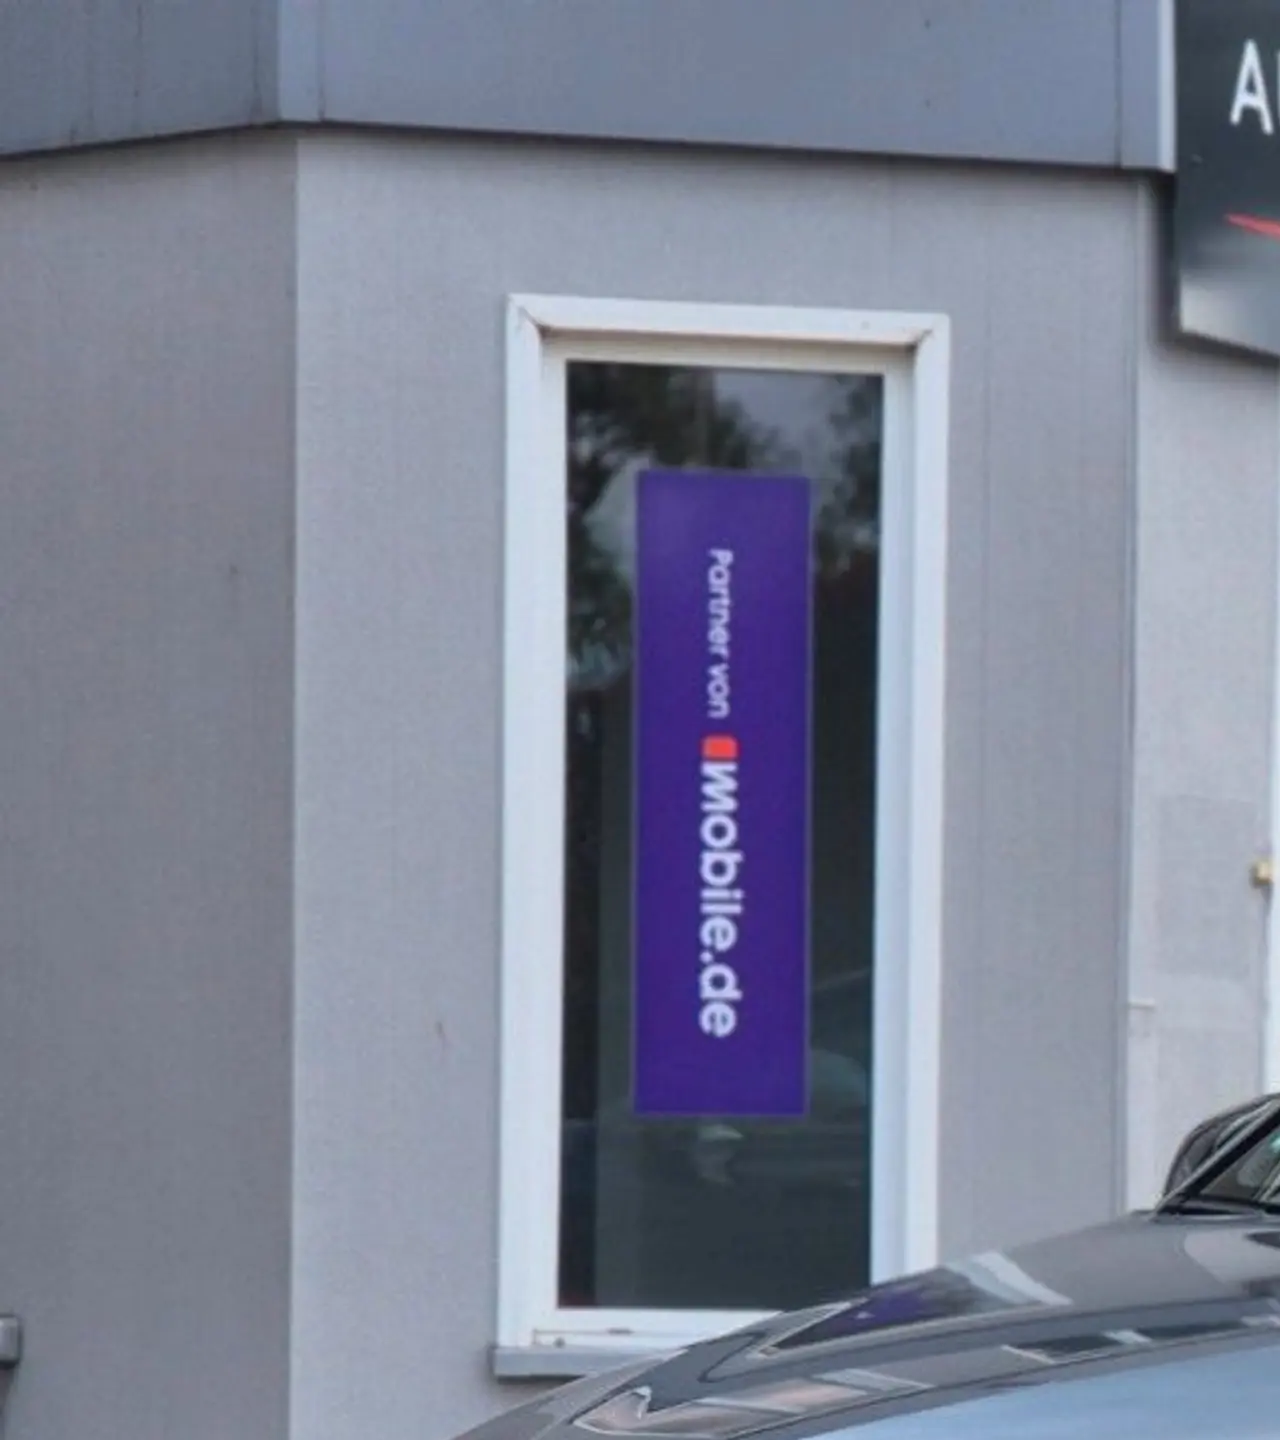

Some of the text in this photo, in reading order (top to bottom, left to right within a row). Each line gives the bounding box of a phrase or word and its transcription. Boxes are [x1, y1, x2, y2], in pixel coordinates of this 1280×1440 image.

[700, 548, 744, 1038] Partner von mobile.de
